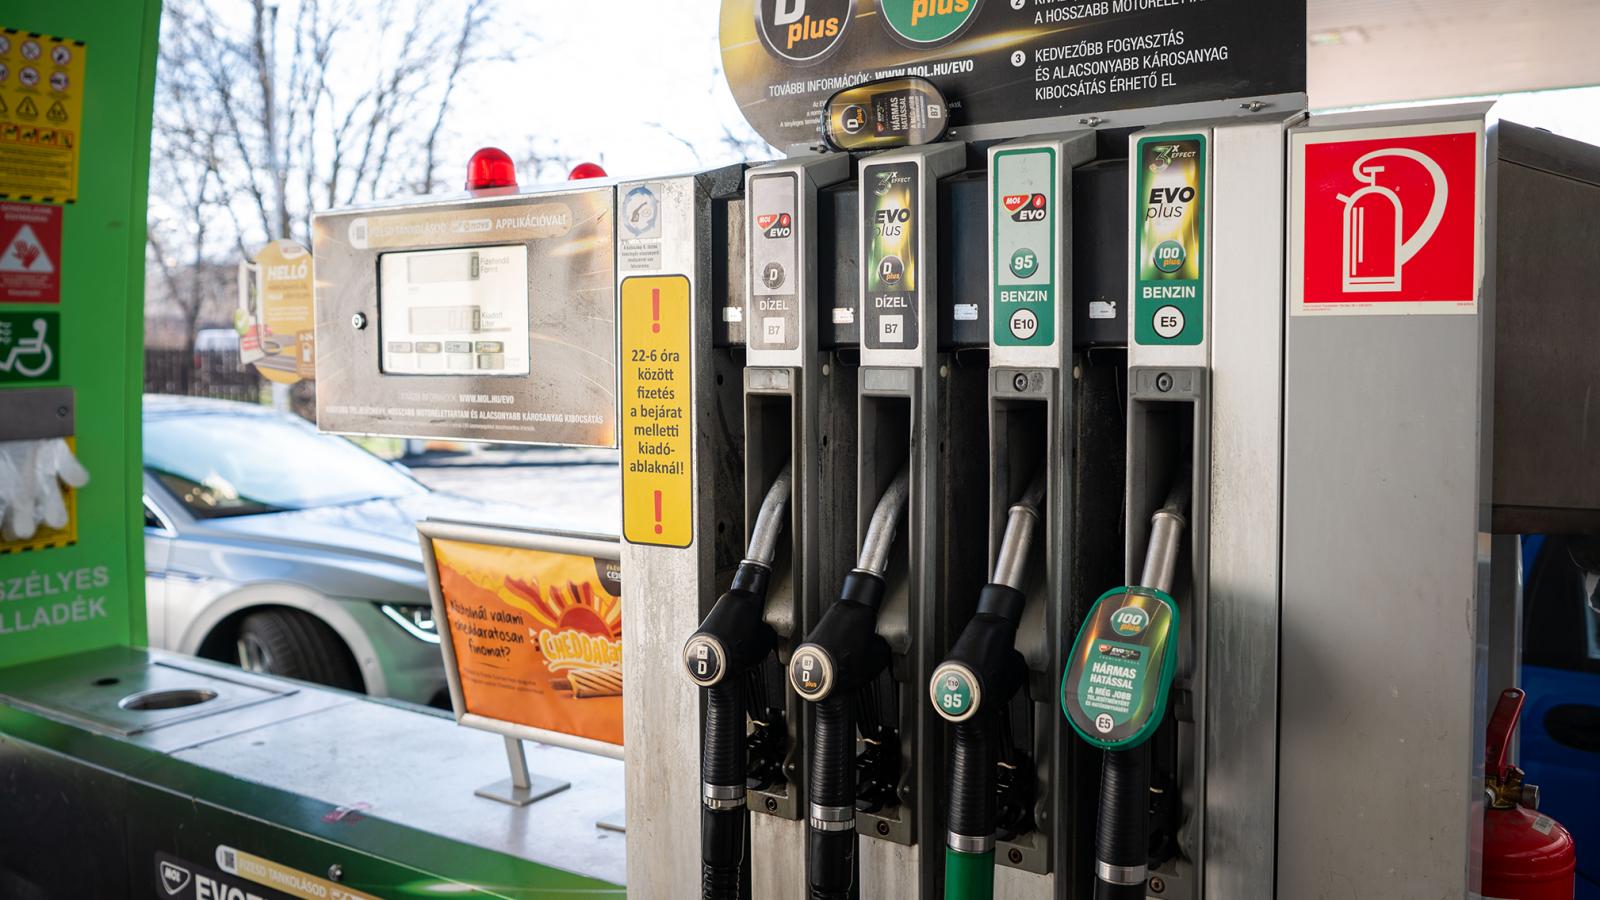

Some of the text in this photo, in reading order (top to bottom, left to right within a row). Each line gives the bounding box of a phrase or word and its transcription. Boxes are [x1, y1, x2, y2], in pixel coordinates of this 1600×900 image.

[1034, 11, 1043, 24] A
[1046, 2, 1109, 22] HOSSZABB
[787, 15, 839, 49] plus
[1014, 29, 1185, 65] 3 KEDVEZŐBB FOGYASZTÁS
[1035, 45, 1229, 82] ÉS ALACSONYABB KÁROSANYAG
[769, 81, 805, 97] TOVÁBBI
[1035, 71, 1177, 101] KIBOCSÁTÁS ÉRHETŐ EL
[890, 97, 900, 131] HÁRMAS
[899, 96, 909, 130] HATÁSSAL
[1171, 152, 1196, 160] EFFECT
[1149, 187, 1195, 205] EVO
[875, 208, 911, 224] EVO
[1020, 210, 1045, 221] EVO
[1145, 203, 1183, 222] plus
[770, 228, 791, 238] EVO
[1159, 247, 1180, 260] 100
[883, 262, 892, 275] D
[1014, 256, 1034, 270] 95
[769, 269, 779, 282] D
[875, 294, 908, 308] DÍZEL
[1001, 290, 1049, 303] BENZIN
[1143, 287, 1196, 300] BENZIN
[760, 299, 790, 311] DÍZEL
[884, 324, 899, 334] B7
[1013, 319, 1035, 330] E10
[1160, 317, 1178, 328] E5
[767, 325, 781, 336] B7
[631, 349, 681, 363] 22-6 óra
[637, 367, 674, 382] között
[637, 385, 675, 401] fizetés
[630, 403, 683, 422] a bejárat
[634, 423, 680, 438] melletti
[638, 441, 676, 456] kiadó-
[629, 459, 685, 475] ablaknál!
[490, 610, 525, 625] valami
[1117, 612, 1143, 625] 100
[469, 638, 511, 662] finomat?
[698, 660, 708, 675] D
[1092, 661, 1137, 680] HÁRMAS
[802, 670, 810, 682] D
[1089, 673, 1134, 690] HATÁSSAL
[943, 693, 962, 708] 95
[1094, 687, 1111, 698] MÉG
[1112, 690, 1132, 702] JOBB
[1097, 717, 1111, 730] E5
